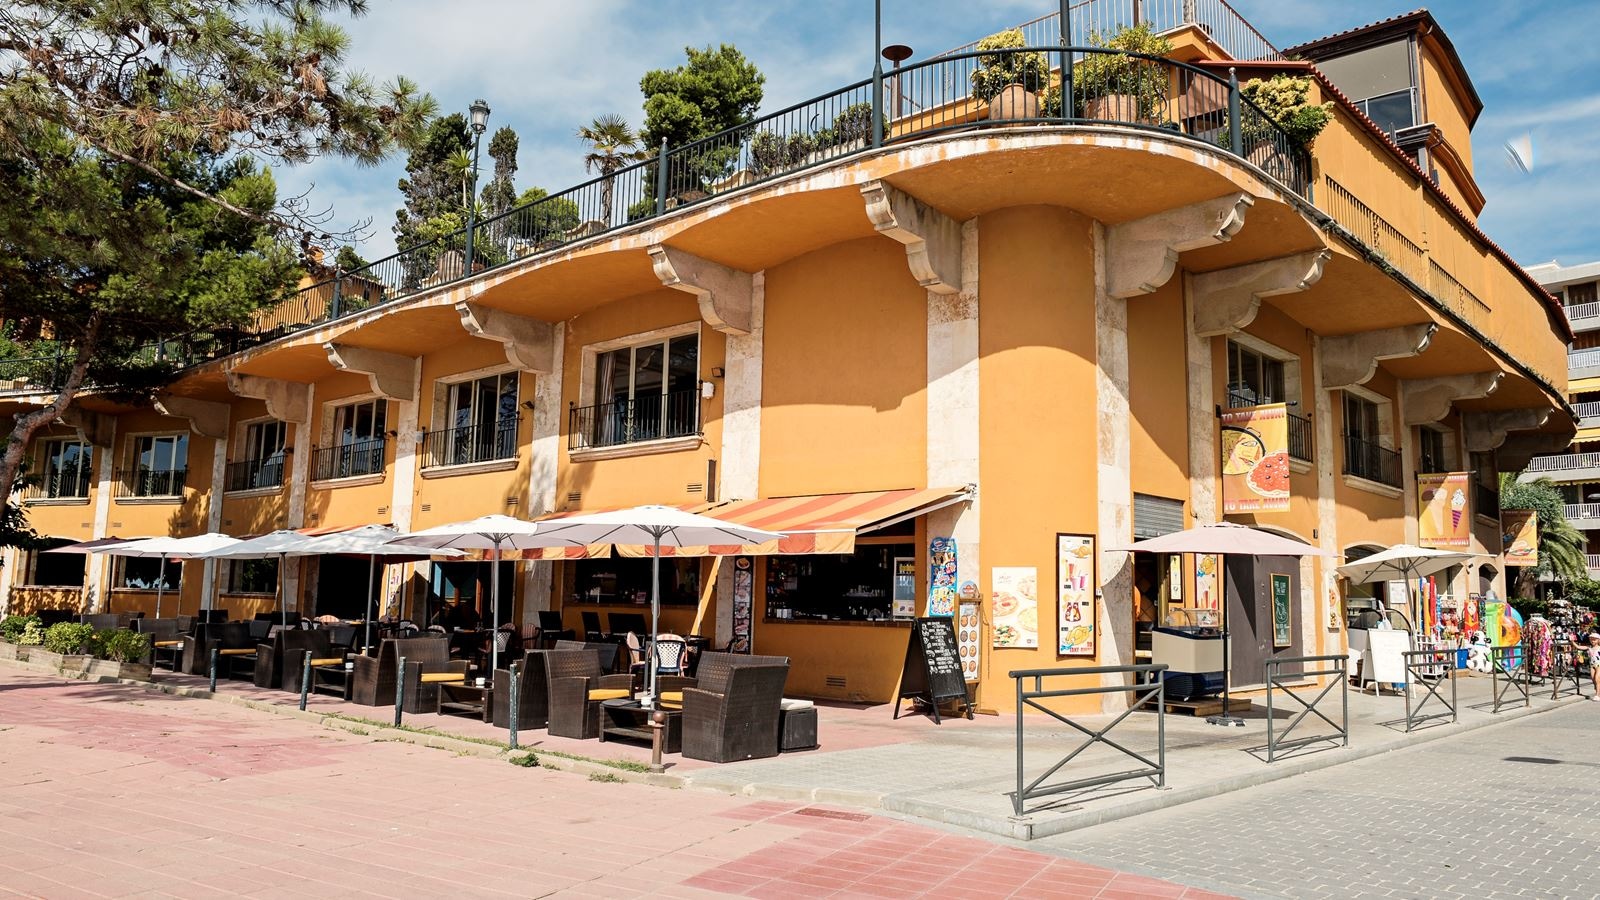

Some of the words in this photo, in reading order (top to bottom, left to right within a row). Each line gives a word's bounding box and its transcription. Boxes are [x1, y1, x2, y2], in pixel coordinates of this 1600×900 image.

[1221, 413, 1233, 423] TO
[1236, 411, 1257, 422] TAKE
[1260, 408, 1285, 420] AWAY
[1224, 499, 1236, 511] TO
[1238, 498, 1260, 510] TAKE
[1263, 497, 1289, 509] AWAY
